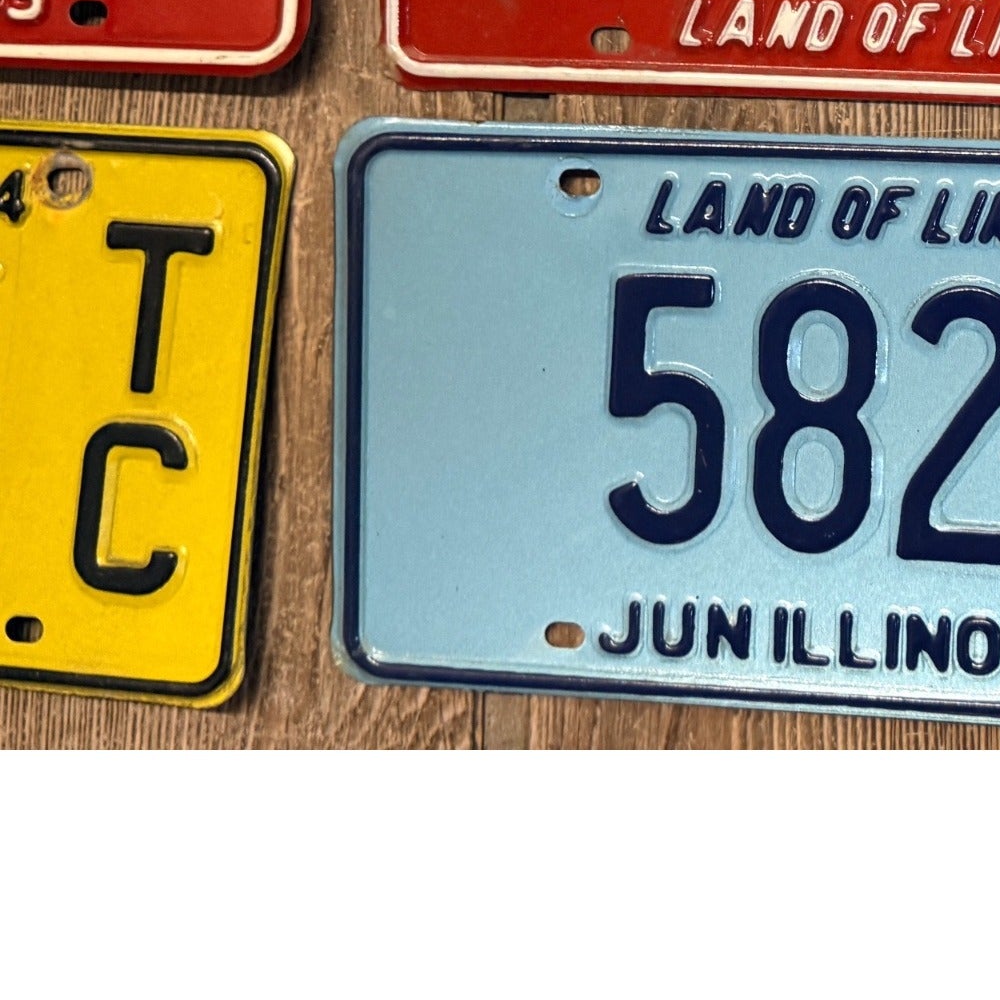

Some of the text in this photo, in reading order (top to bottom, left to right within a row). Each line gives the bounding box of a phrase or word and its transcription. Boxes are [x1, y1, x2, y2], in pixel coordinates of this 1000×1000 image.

[864, 2, 941, 53] OF
[645, 179, 816, 239] LAND
[831, 183, 915, 240] OF
[598, 600, 751, 659] JUN
